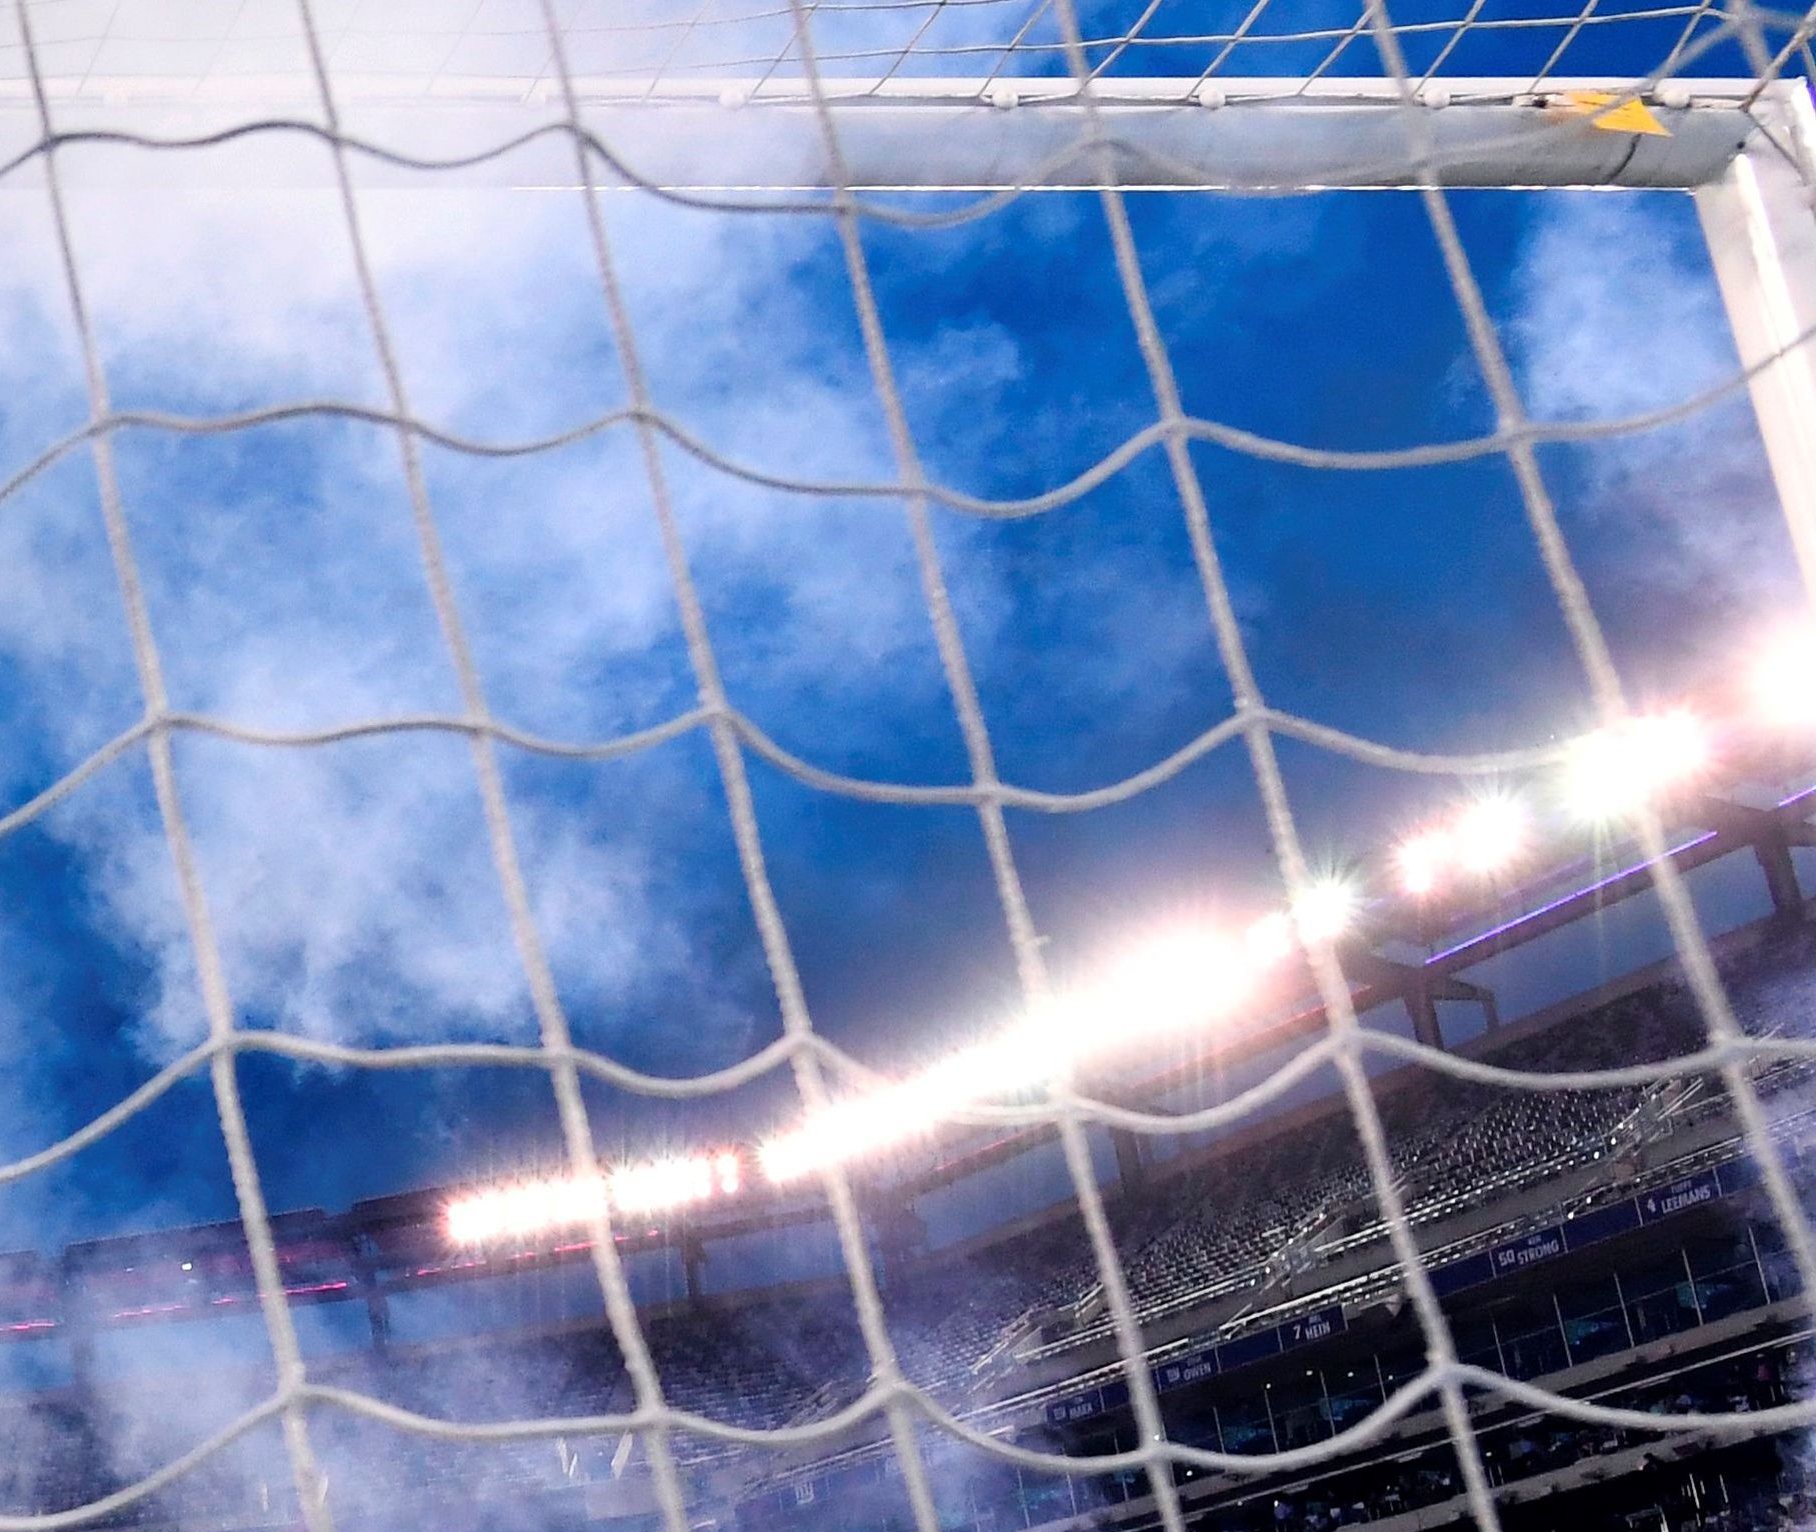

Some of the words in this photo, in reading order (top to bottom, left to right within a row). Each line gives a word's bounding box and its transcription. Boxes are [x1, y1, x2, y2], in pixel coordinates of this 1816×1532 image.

[1661, 1187, 1711, 1214] LEEMANS
[1518, 1239, 1560, 1264] STRONG
[1293, 1325, 1301, 1340] 7
